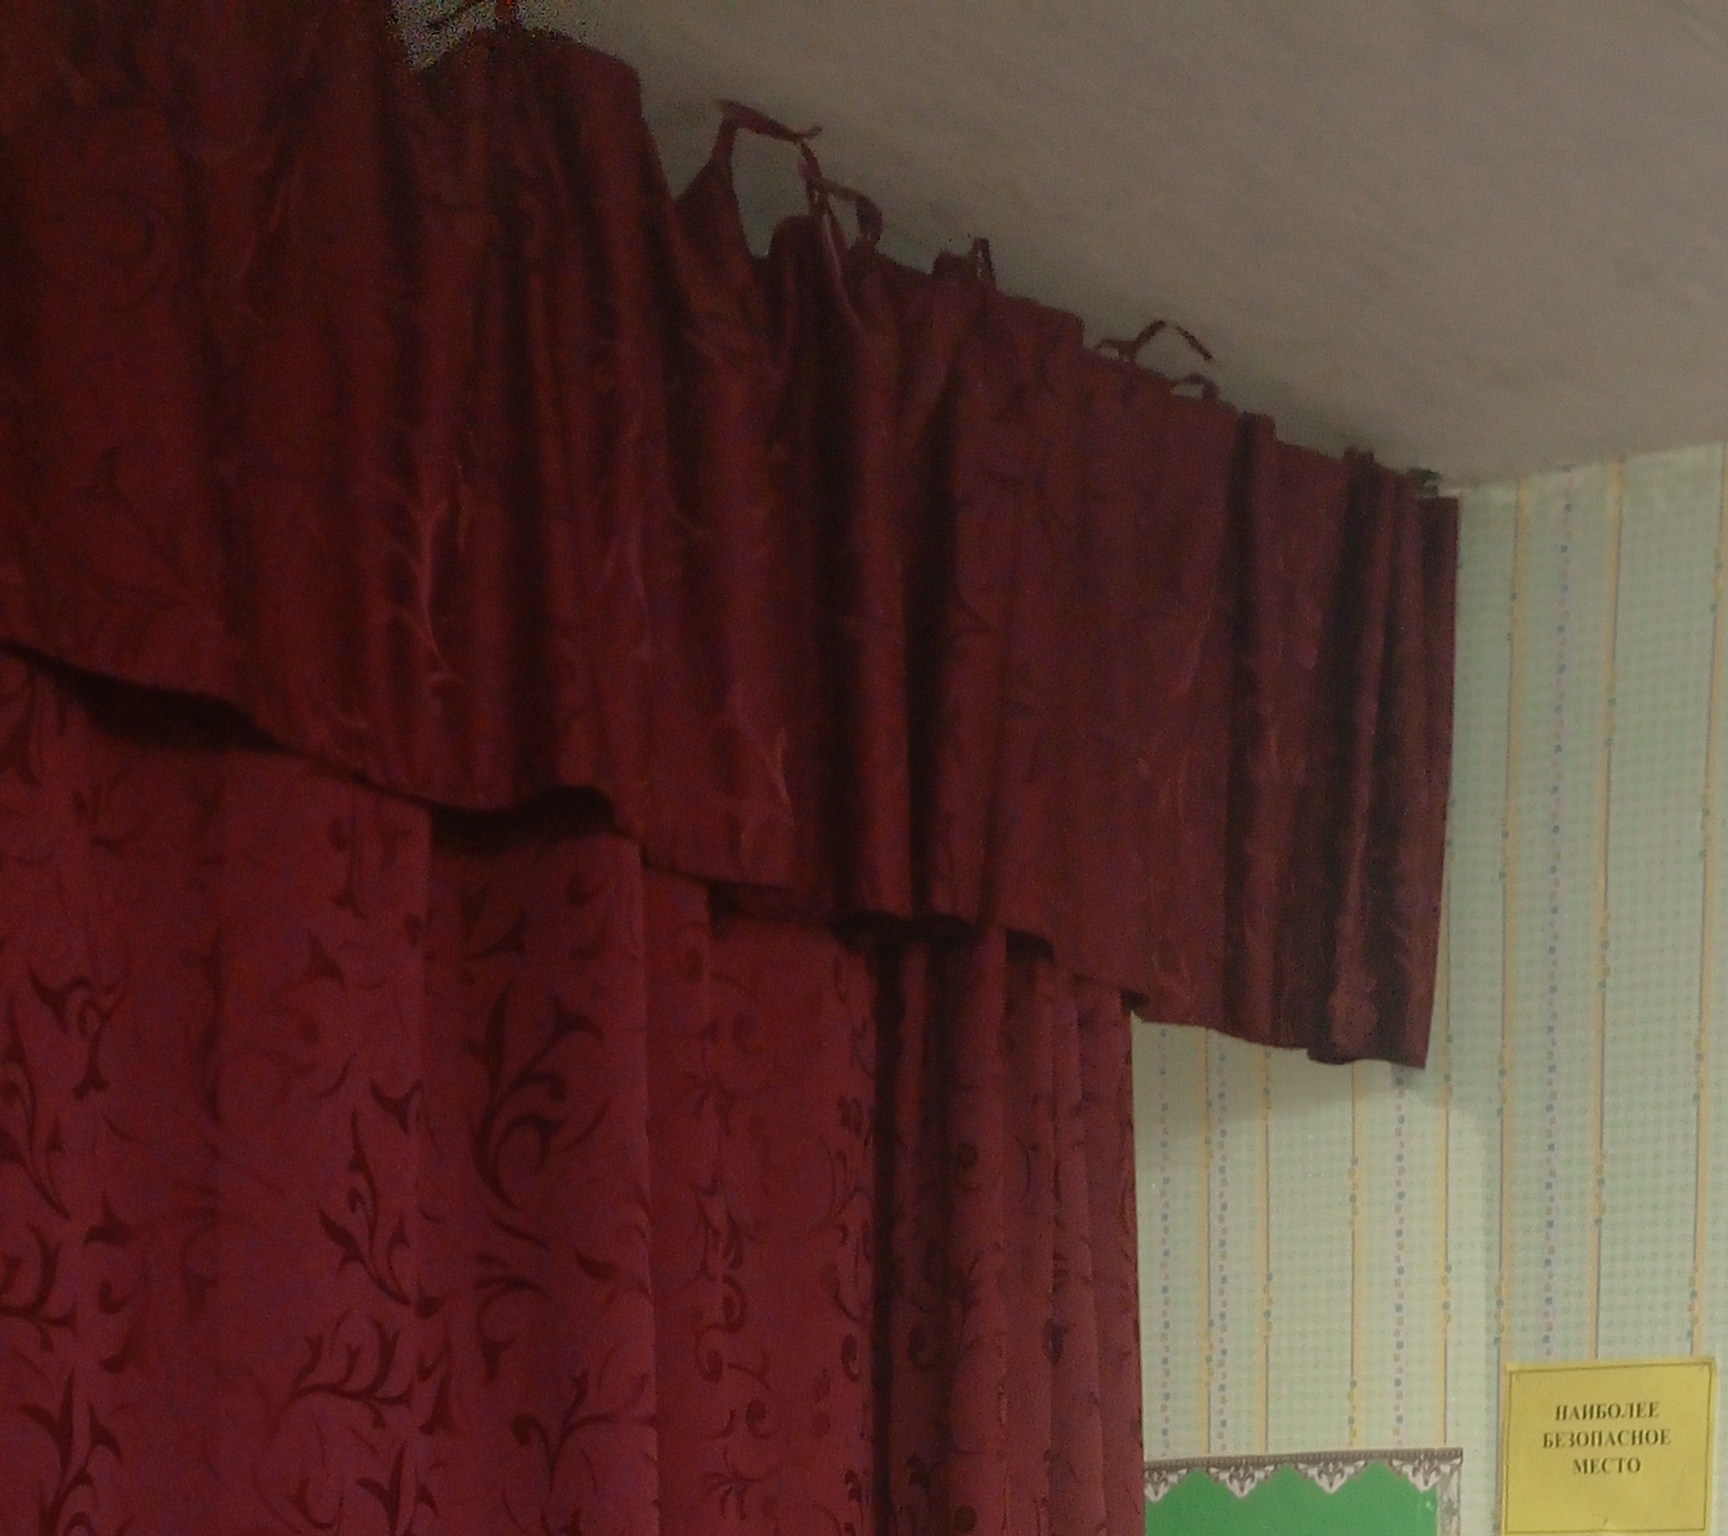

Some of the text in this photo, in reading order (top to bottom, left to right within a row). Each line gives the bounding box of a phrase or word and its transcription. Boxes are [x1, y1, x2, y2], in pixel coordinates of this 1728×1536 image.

[1554, 1401, 1660, 1422] НАИБОЛЕЕ
[1542, 1428, 1672, 1449] БЕЗОПАСНОЕ
[1571, 1456, 1642, 1475] МЕСТО
